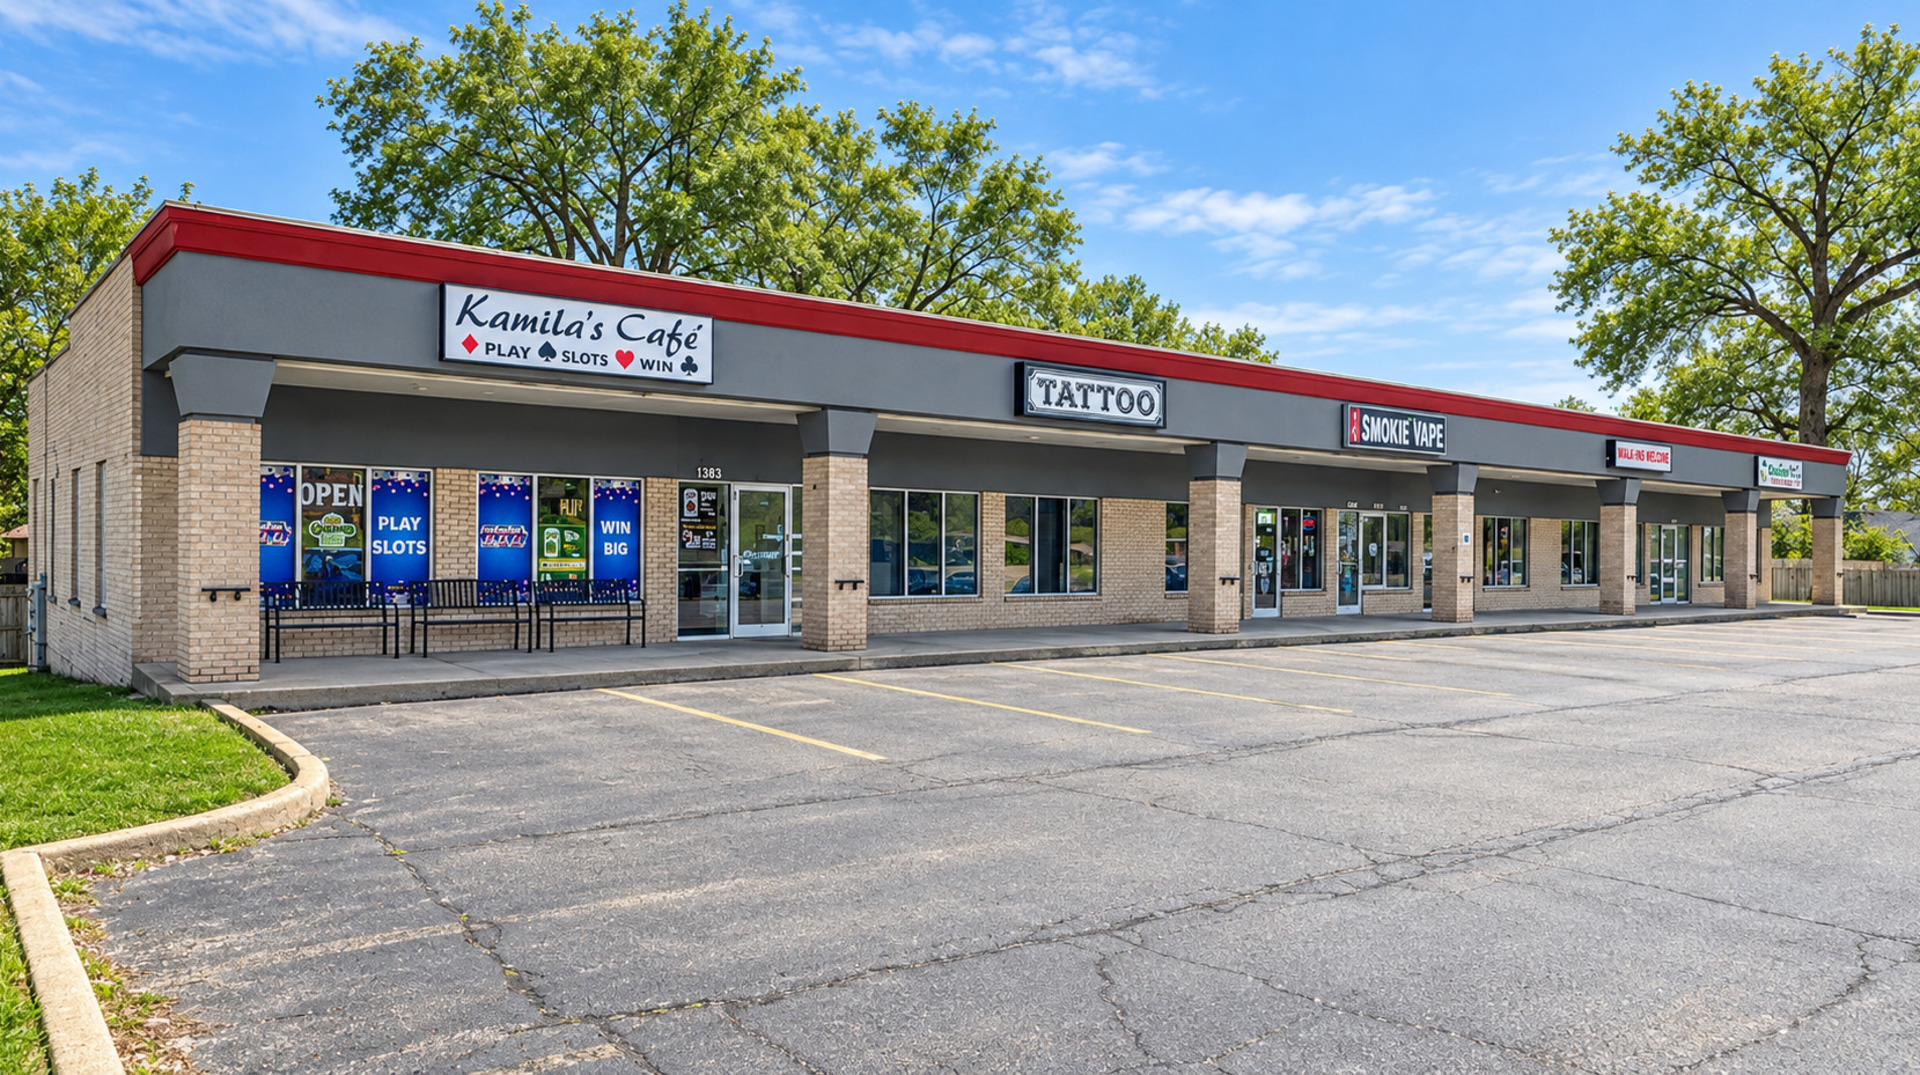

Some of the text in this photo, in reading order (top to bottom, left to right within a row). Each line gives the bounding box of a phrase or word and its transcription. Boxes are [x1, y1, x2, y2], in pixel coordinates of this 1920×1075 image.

[455, 293, 703, 358] Kamila's Café
[484, 341, 673, 373] PLAY SLOTS WIN
[1036, 376, 1155, 416] TATTOO
[1361, 413, 1444, 448] SMOKIE VAPE
[697, 467, 722, 479] 1383
[301, 482, 364, 507] OPEN
[378, 516, 422, 531] PLAY
[600, 520, 631, 534] WIN
[372, 540, 427, 555] SLOTS
[603, 542, 629, 556] BIG
